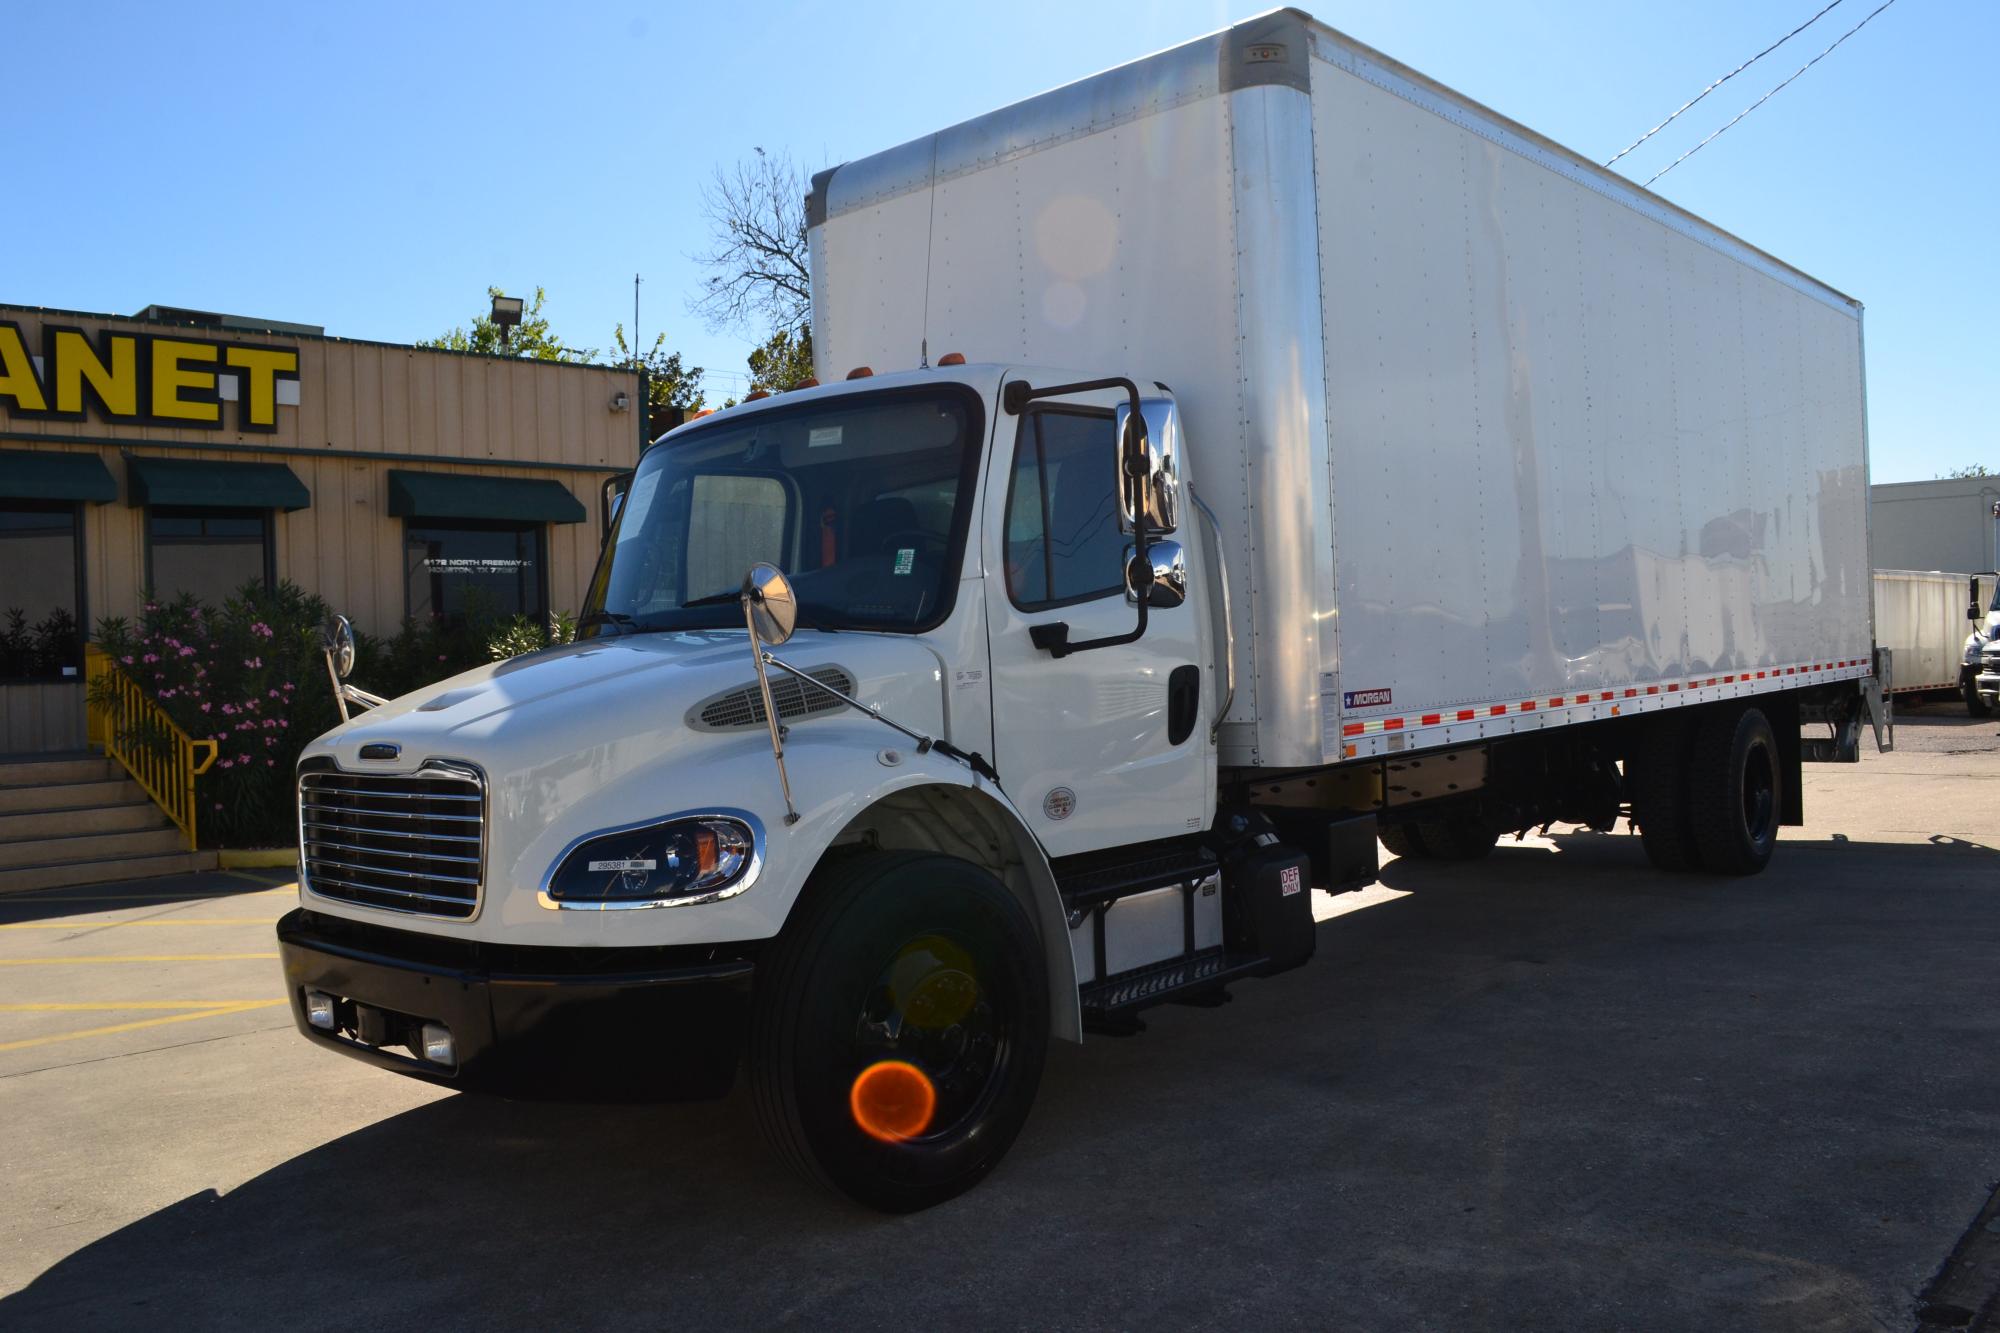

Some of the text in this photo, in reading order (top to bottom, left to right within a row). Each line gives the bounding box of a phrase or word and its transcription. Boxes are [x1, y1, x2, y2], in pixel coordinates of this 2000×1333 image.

[1353, 690, 1391, 706] MORGAN
[598, 861, 625, 870] 295381
[1281, 868, 1298, 884] DEF
[1283, 881, 1299, 894] ONLY
